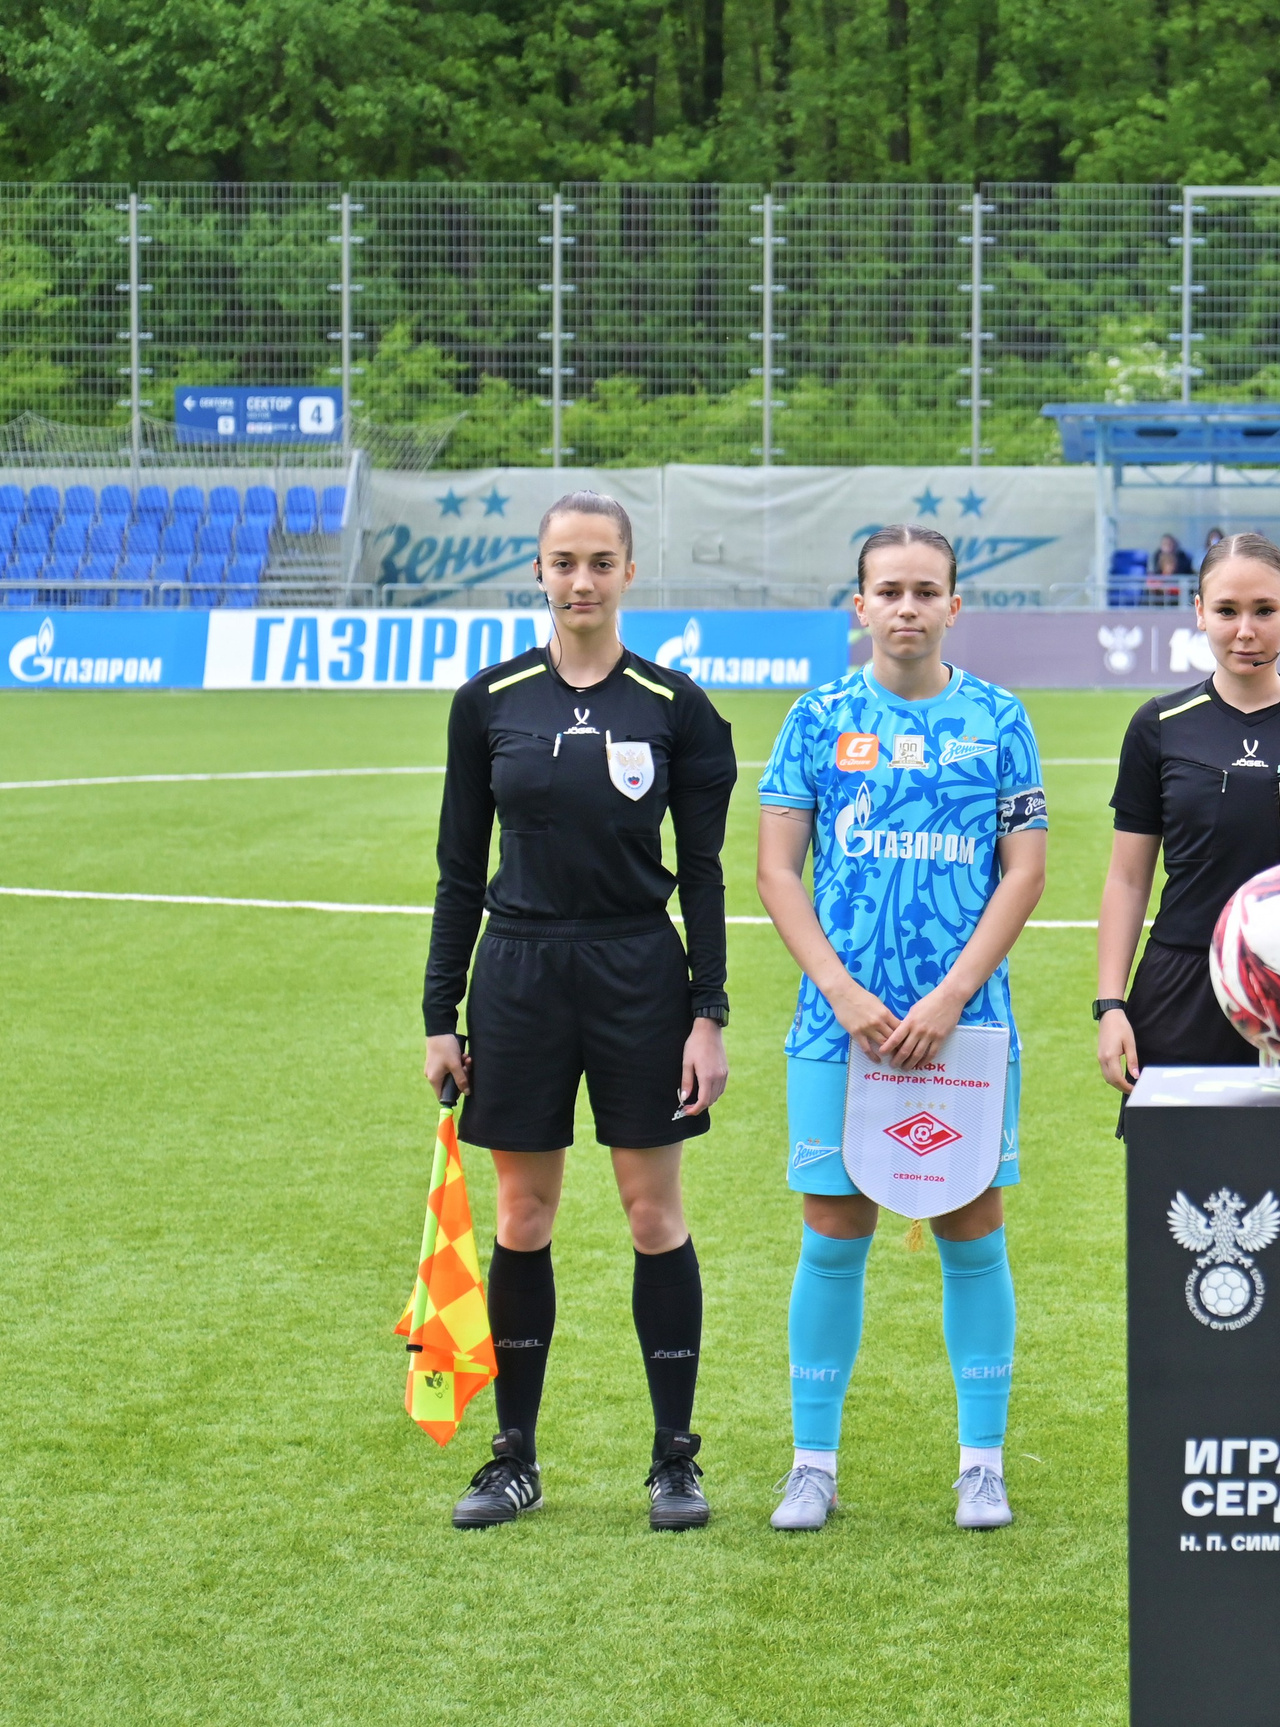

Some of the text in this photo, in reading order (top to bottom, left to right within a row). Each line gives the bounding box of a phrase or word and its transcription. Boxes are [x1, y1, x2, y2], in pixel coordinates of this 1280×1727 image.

[310, 404, 323, 426] 4
[53, 657, 163, 684] ГАЗПРОМ
[700, 657, 810, 684] ГАЗПРОМ
[873, 830, 976, 865] ГАЗПРОМ
[863, 1072, 990, 1089] «Спартак-Москва»
[892, 1172, 945, 1183] СЕЗОН 2026
[494, 1338, 544, 1348] JÖGEL
[650, 1349, 696, 1359] JÖGEL
[789, 1364, 839, 1382] ЕНИТ
[1180, 1535, 1201, 1551] Н.
[1206, 1535, 1227, 1551] П.
